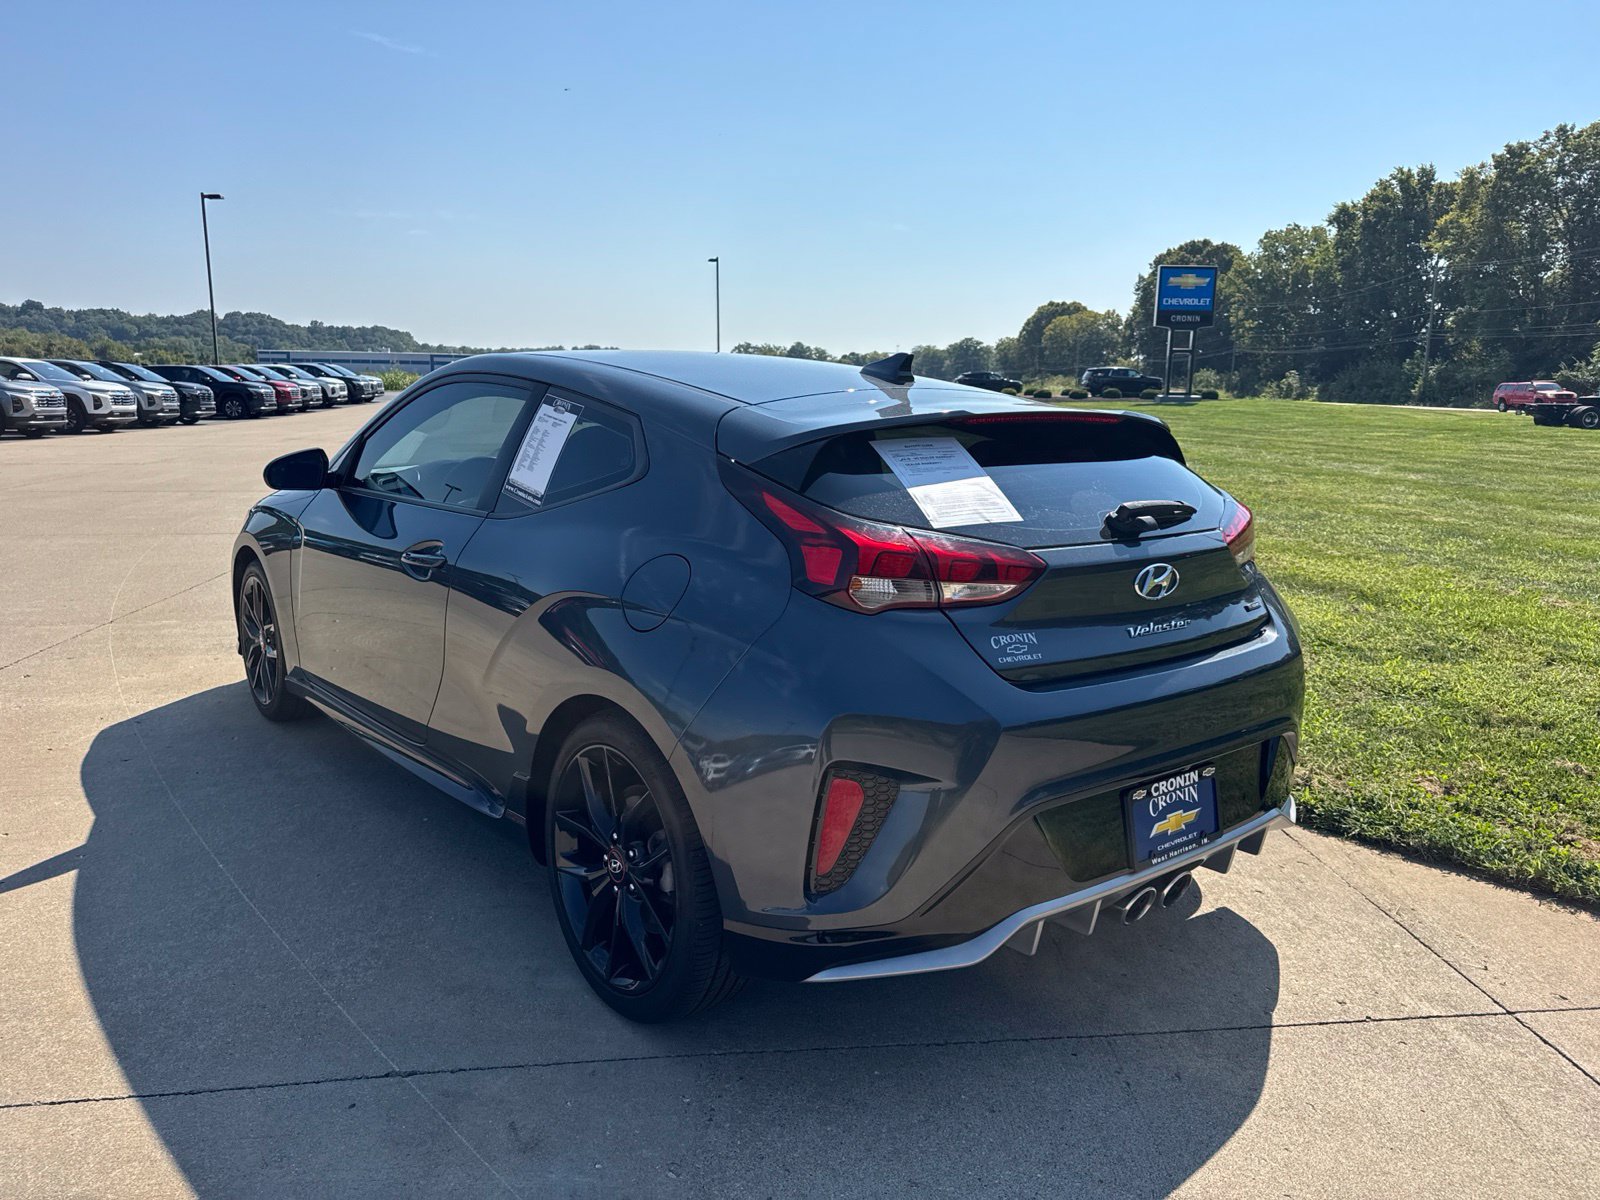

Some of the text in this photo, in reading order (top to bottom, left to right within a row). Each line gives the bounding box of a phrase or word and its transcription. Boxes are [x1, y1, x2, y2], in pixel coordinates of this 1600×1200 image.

[1162, 297, 1211, 306] CHEVROLET
[1127, 619, 1191, 638] Veloster
[990, 632, 1038, 649] CRONIN
[998, 653, 1042, 664] CHEVROLET
[1151, 770, 1199, 797] CRONIN
[1149, 784, 1199, 817] CRONIN
[1157, 832, 1198, 851] CHEVROLET
[1151, 853, 1168, 865] West
[1169, 843, 1199, 857] Harrison,
